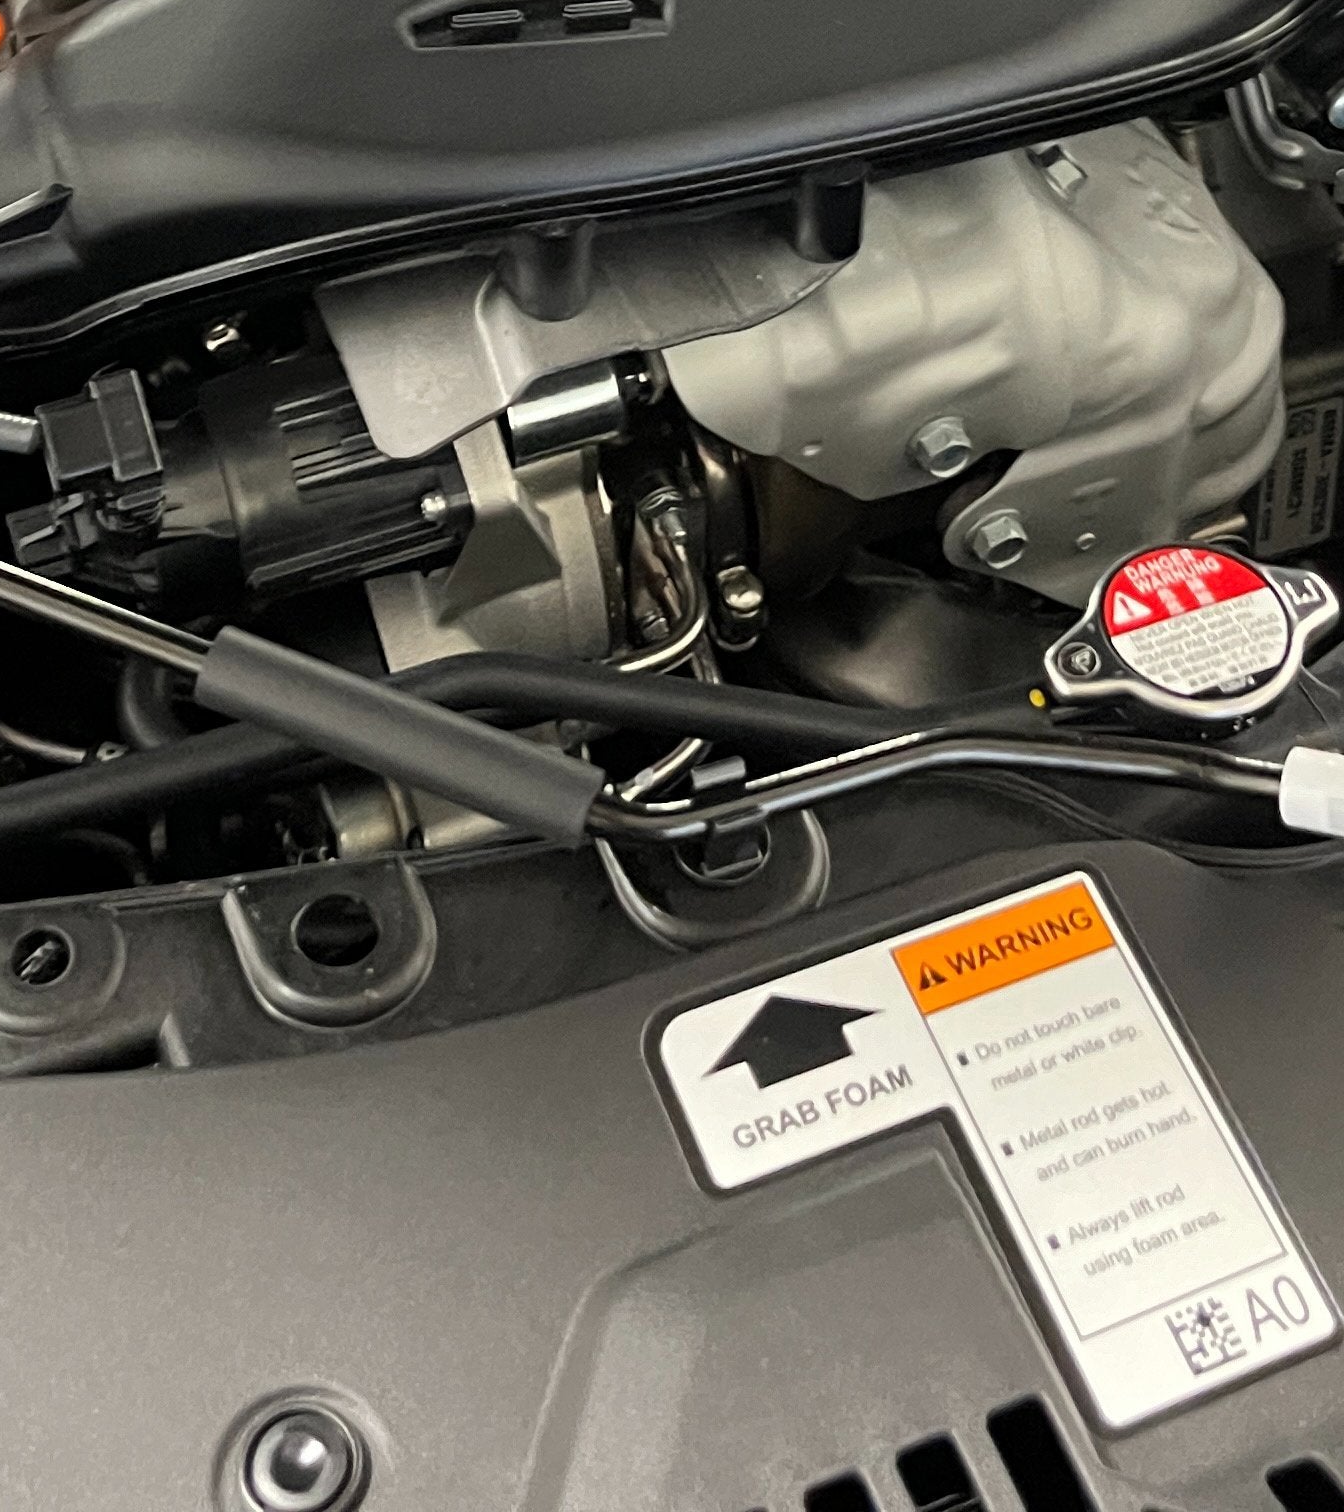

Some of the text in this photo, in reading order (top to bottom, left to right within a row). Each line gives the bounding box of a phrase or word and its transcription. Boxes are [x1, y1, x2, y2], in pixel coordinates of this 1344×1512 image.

[1123, 548, 1197, 580] DANGER
[945, 907, 1093, 975] WARNING
[974, 996, 1122, 1061] Do not touch bare
[990, 1059, 1038, 1091] metal
[1040, 1054, 1057, 1072] or
[1060, 1037, 1106, 1063] white
[732, 1063, 913, 1148] GRAB FOAM
[1019, 1118, 1069, 1151] Metal
[1071, 1106, 1101, 1131] rod
[1102, 1094, 1140, 1122] gets
[1037, 1154, 1070, 1182] and
[1072, 1144, 1105, 1168] can
[1105, 1126, 1147, 1154] burn
[1069, 1183, 1186, 1245] Always lift rod
[1083, 1210, 1226, 1276] using foam area.
[1245, 1274, 1310, 1344] A0
